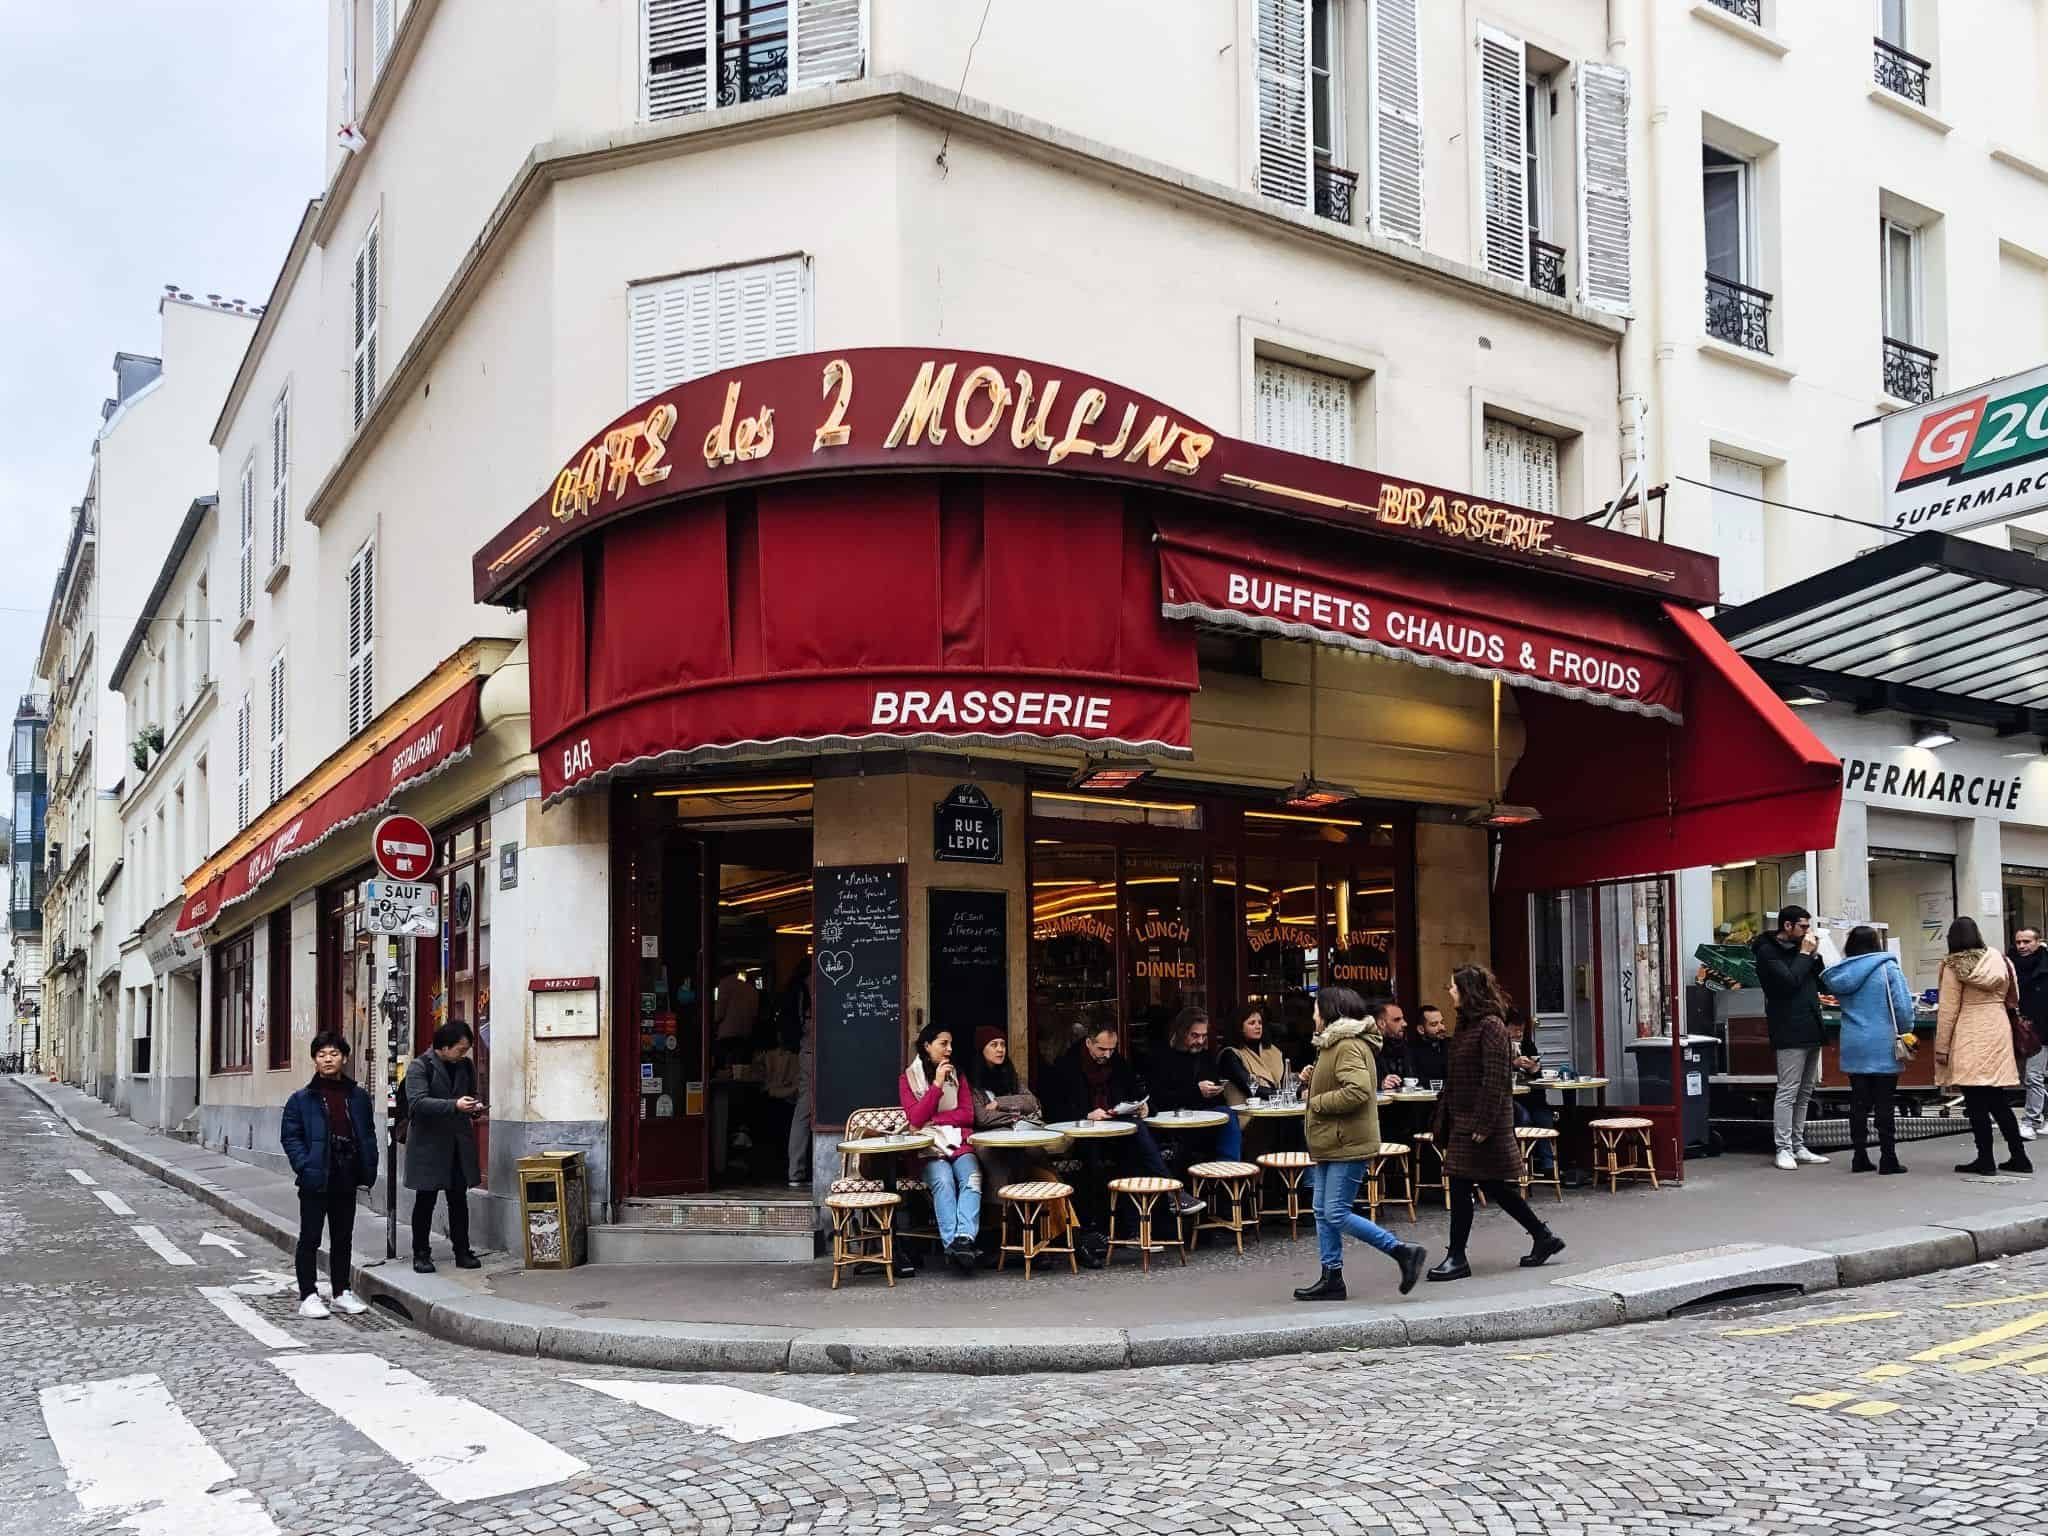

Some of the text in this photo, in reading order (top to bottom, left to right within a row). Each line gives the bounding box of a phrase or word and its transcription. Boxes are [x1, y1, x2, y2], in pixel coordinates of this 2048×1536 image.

[704, 381, 775, 468] des
[813, 359, 853, 453] 2
[883, 361, 1215, 471] MOULINS
[1376, 484, 1555, 556] BRASSERIE
[1228, 573, 1641, 694] BUFFETS CHAUDS & FROIDS
[871, 691, 1111, 729] BRASSERIE
[391, 724, 444, 781] RESTAURANT
[563, 739, 593, 781] BAR
[1840, 758, 2022, 810] PERMARCHÉ
[955, 818, 984, 833] RUE
[948, 835, 989, 850] LEPIC
[385, 885, 422, 899] SAUF
[1037, 914, 1114, 943] CHAMPAGNE
[1135, 921, 1190, 943] LUNCH
[1336, 930, 1387, 952] SERVICE
[1136, 961, 1196, 978] DINNER
[1334, 964, 1389, 981] CONTINU
[544, 980, 581, 989] MENU
